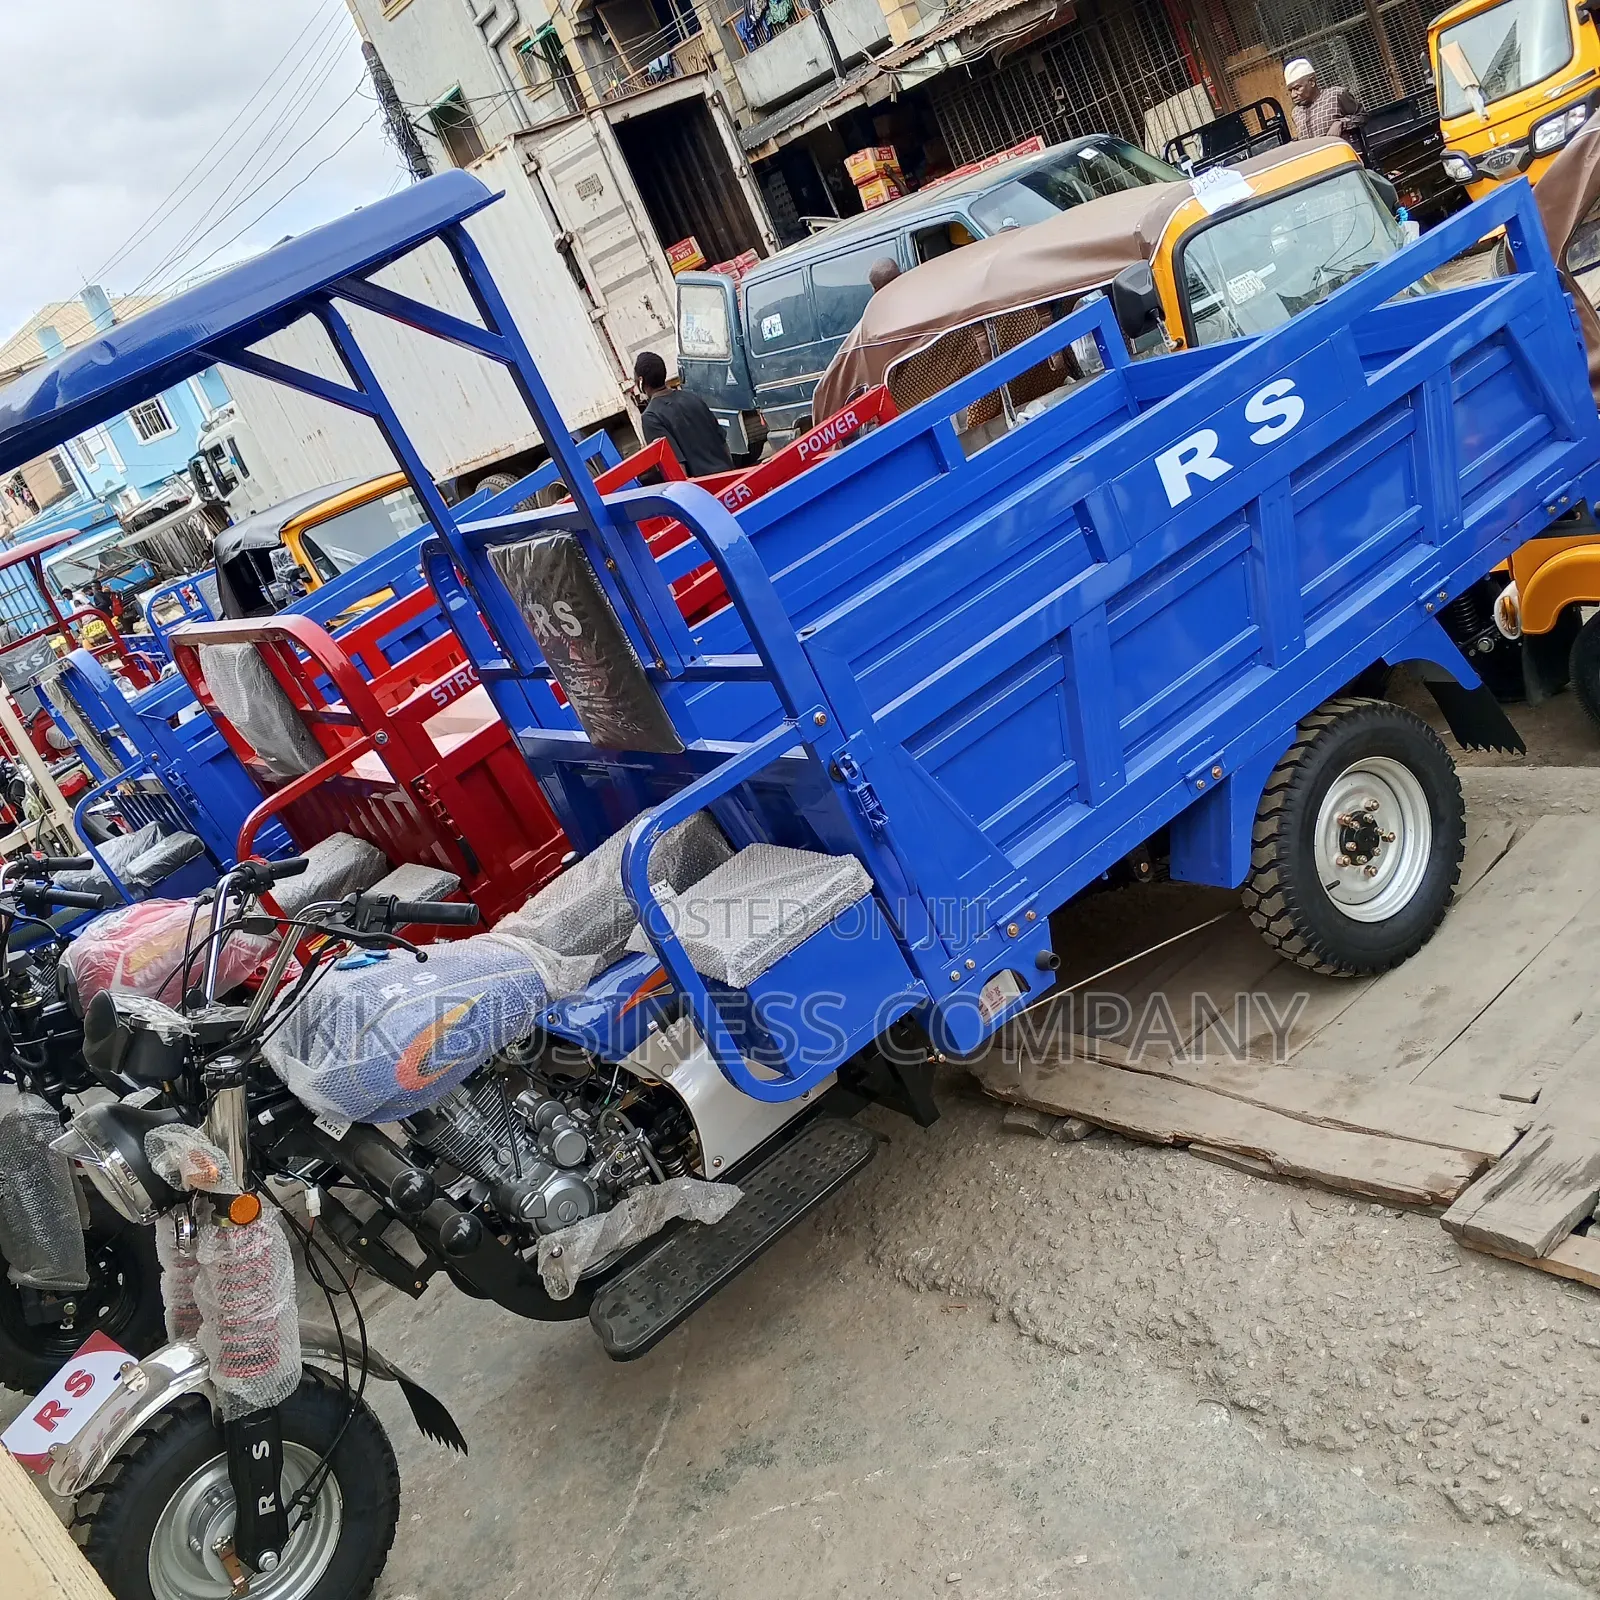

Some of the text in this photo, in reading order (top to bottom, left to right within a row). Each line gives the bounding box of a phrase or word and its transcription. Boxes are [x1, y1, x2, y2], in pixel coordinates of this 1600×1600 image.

[675, 247, 692, 260] TWIST
[797, 410, 859, 462] POWER
[527, 600, 583, 637] RS
[13, 653, 45, 675] RS
[320, 1119, 343, 1137] A476
